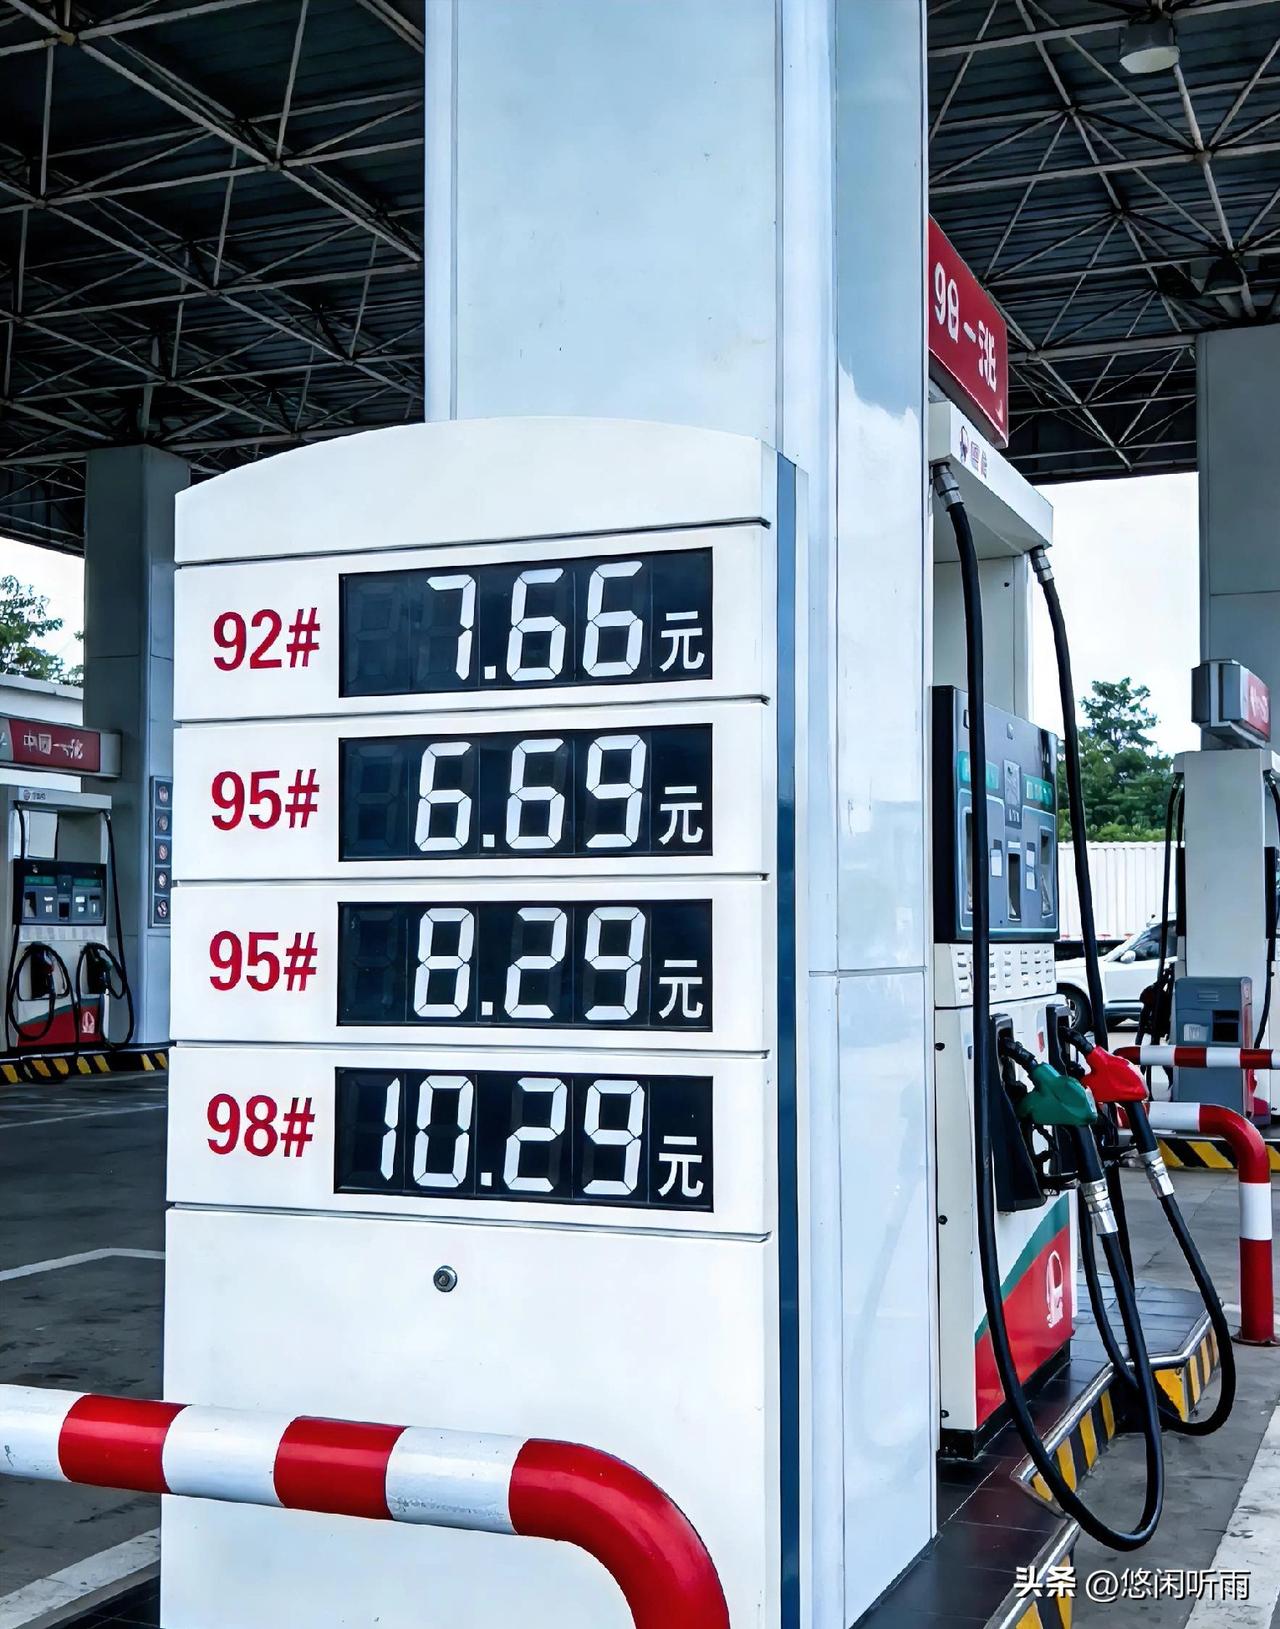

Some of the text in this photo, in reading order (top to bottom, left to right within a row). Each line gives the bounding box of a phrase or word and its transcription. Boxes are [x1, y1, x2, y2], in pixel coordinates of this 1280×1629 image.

[214, 561, 705, 682] 92# 7.66 元
[211, 735, 704, 852] 95# 6.69 元
[209, 906, 704, 1020] 95# 8.29 元
[207, 1075, 704, 1198] 98# 10.29 元
